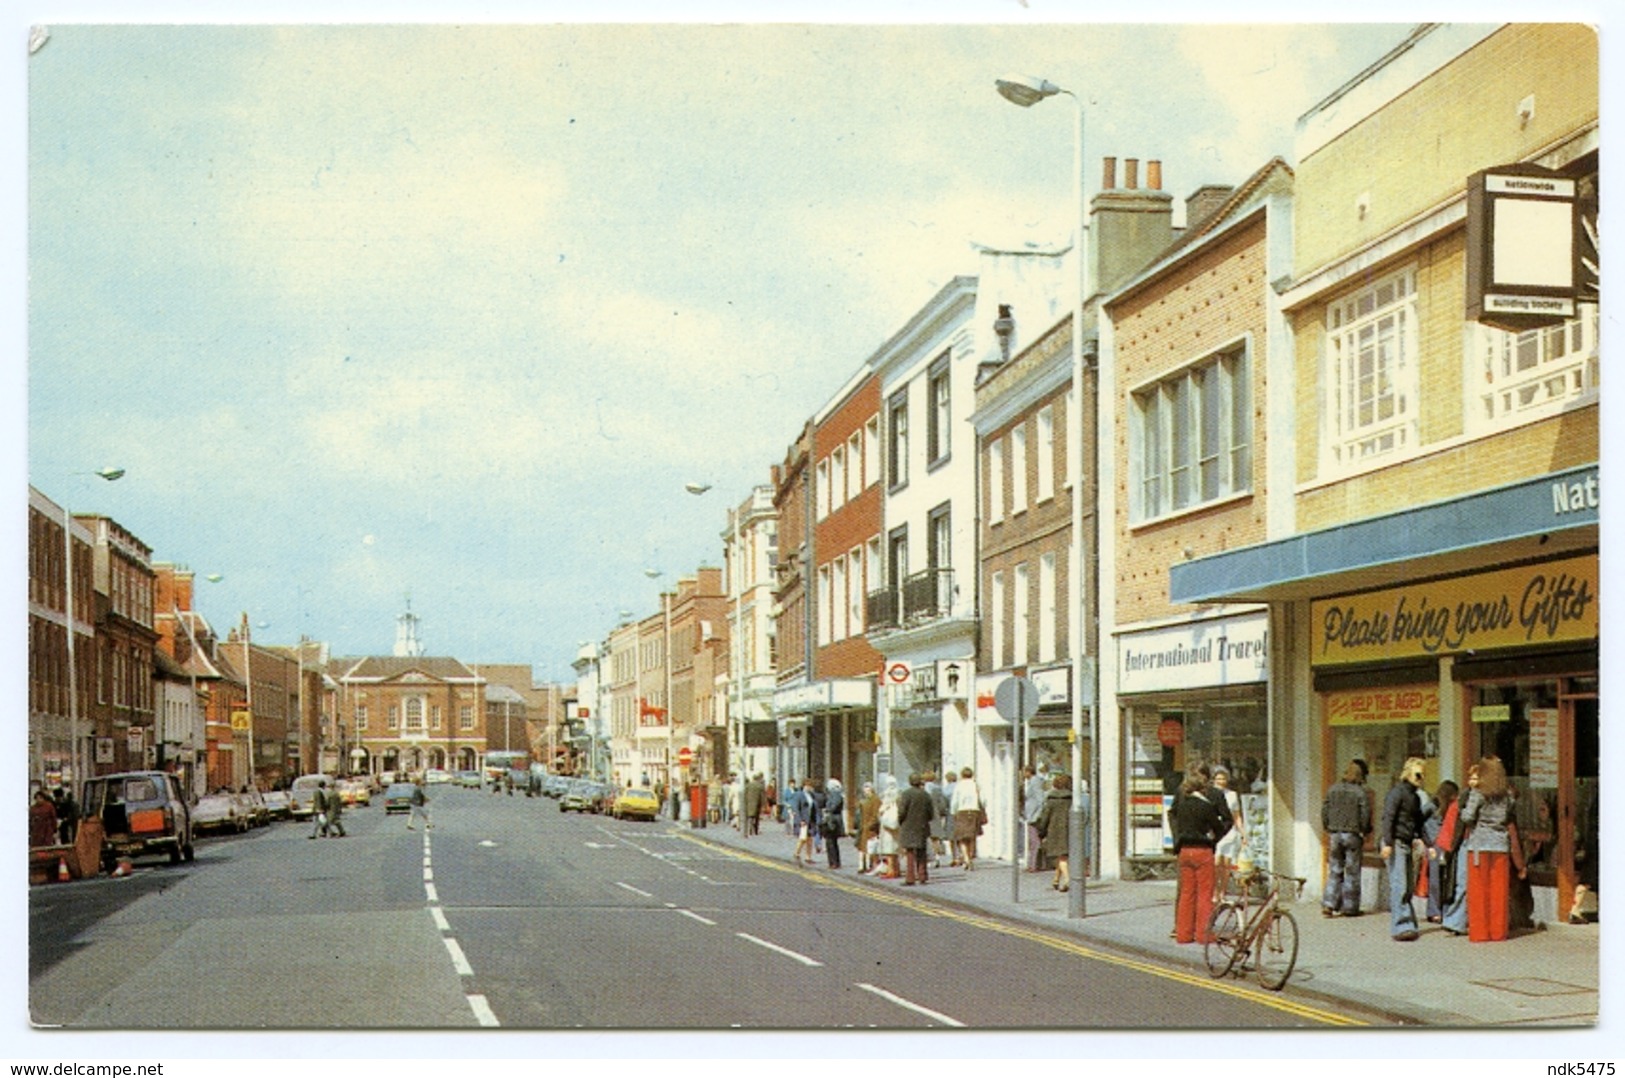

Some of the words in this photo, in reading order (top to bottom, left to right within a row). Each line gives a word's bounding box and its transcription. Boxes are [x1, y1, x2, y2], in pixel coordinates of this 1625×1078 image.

[1504, 179, 1555, 192] Nationwide
[1552, 474, 1599, 514] Nat
[1323, 605, 1388, 656] Please
[1391, 596, 1450, 652] bring
[1444, 594, 1513, 650] your
[1519, 573, 1592, 640] Gifts
[1125, 638, 1212, 673] International
[1374, 693, 1393, 711] THE
[1395, 691, 1423, 710] AGED
